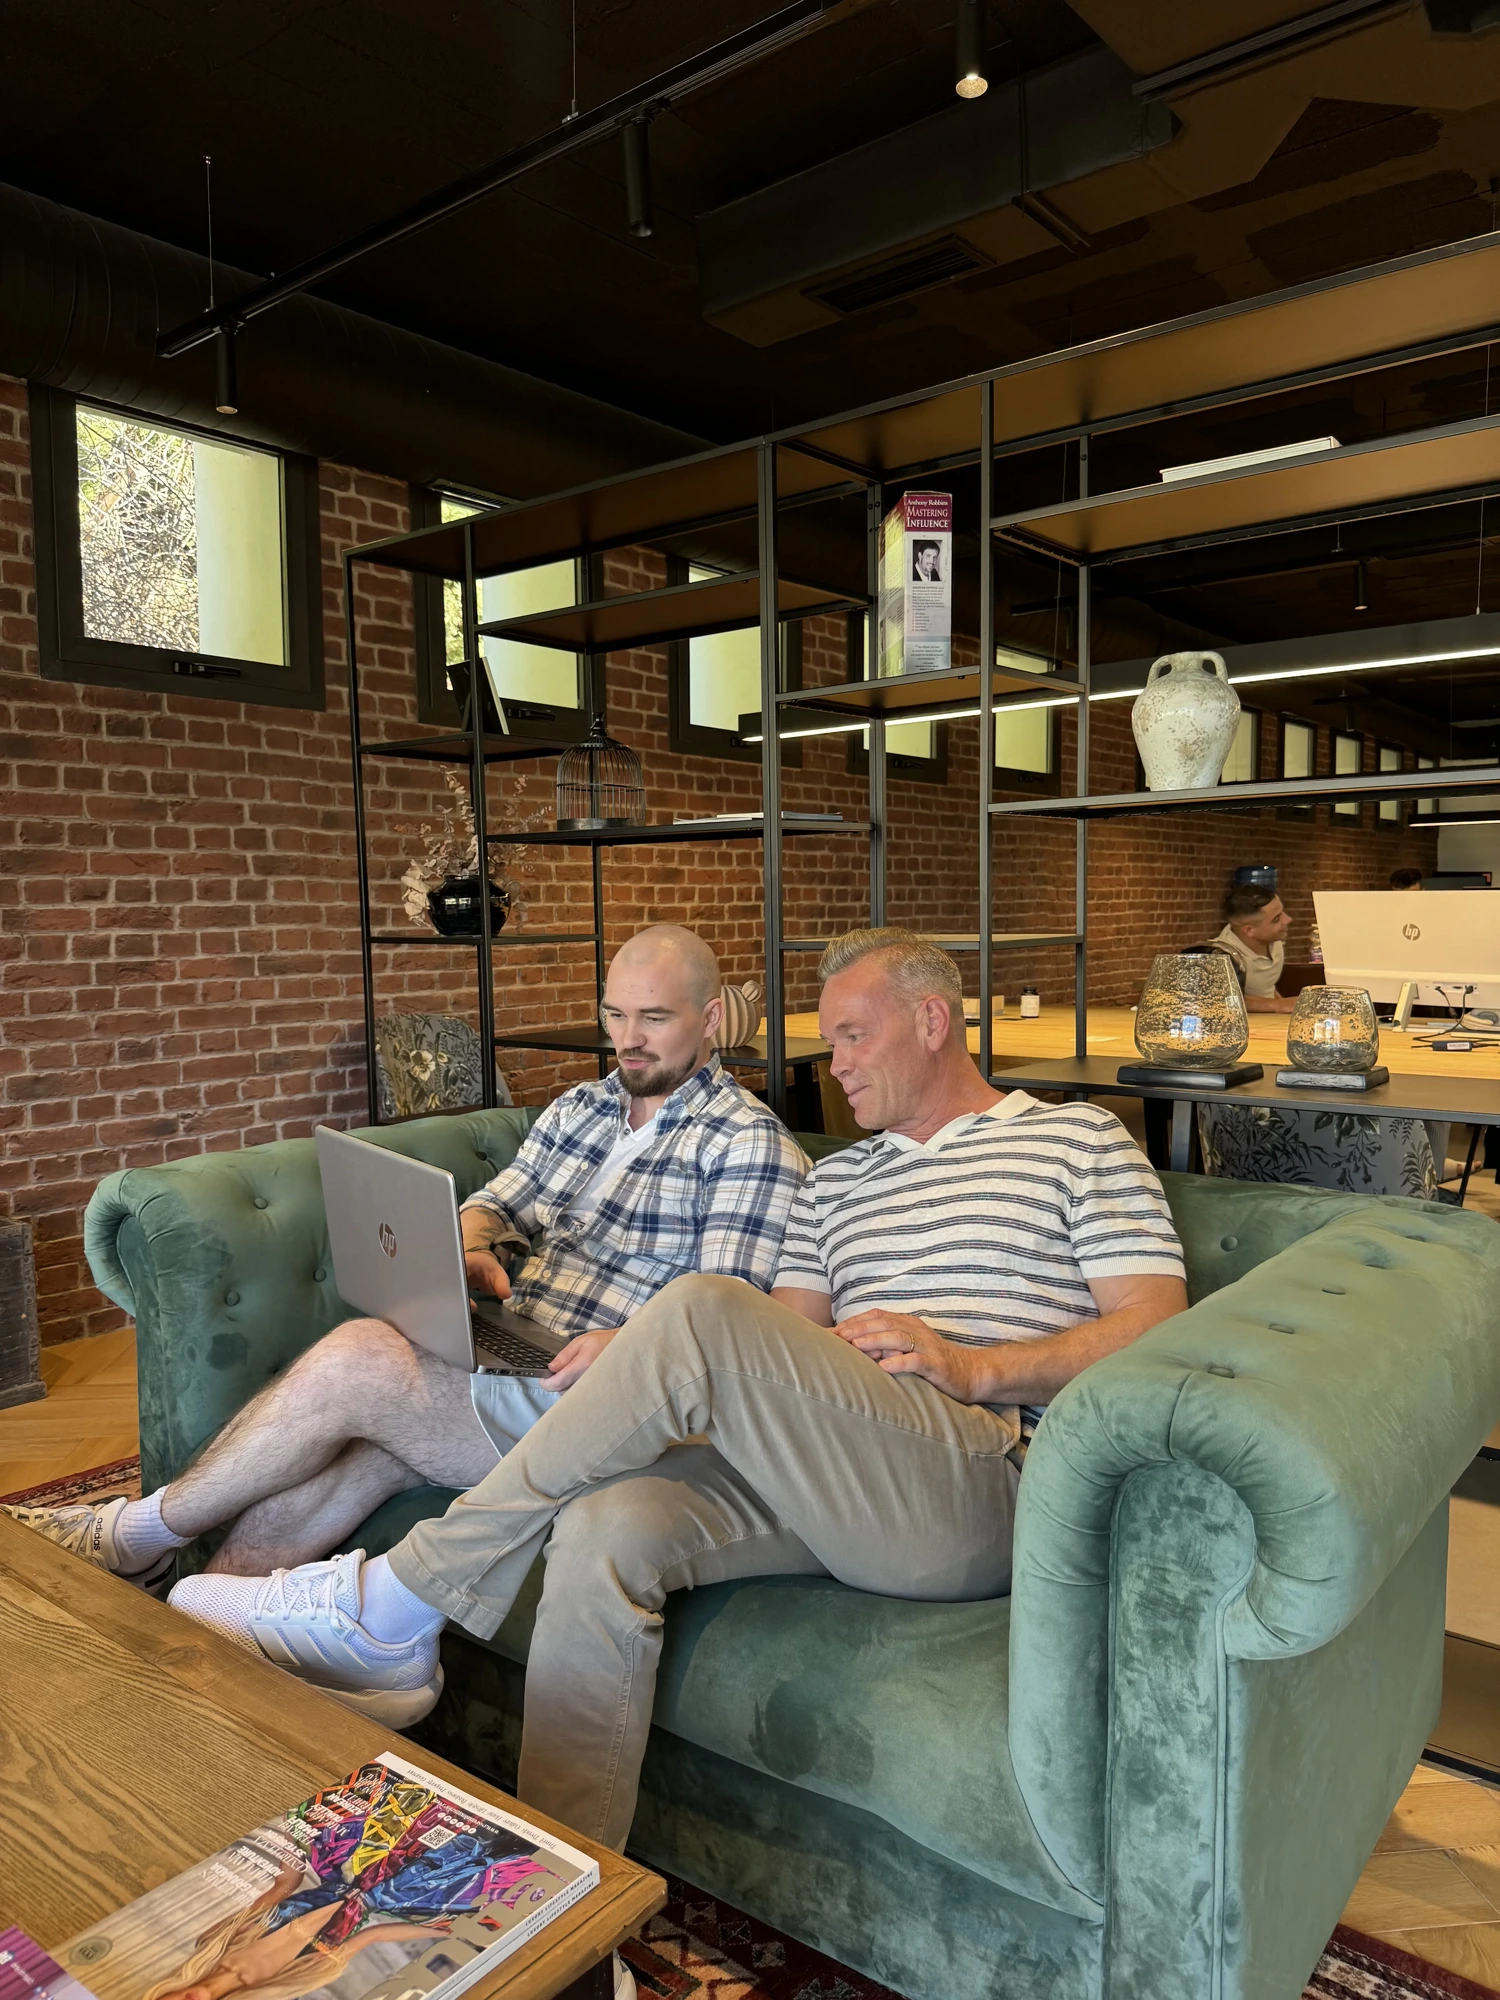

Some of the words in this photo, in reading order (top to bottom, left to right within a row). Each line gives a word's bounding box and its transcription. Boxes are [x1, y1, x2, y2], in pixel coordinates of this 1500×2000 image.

[906, 506, 948, 517] MASTERING
[907, 499, 928, 507] Anthony
[906, 517, 949, 528] INFLUENCE
[1403, 923, 1420, 941] hp
[380, 1222, 396, 1258] hp
[93, 1517, 104, 1551] adidas
[325, 1792, 365, 1816] AZUREAN
[285, 1814, 323, 1838] AMALFI
[235, 1844, 285, 1877] ADVENTURE
[207, 1861, 254, 1891] GRANADA
[525, 1909, 544, 1926] LUXURY
[545, 1890, 569, 1911] LIFESTYLE
[570, 1871, 593, 1891] MAGAZINE
[527, 1920, 546, 1937] LUXURY
[547, 1900, 570, 1921] LIFESTYLE
[572, 1881, 594, 1901] MAGAZINE
